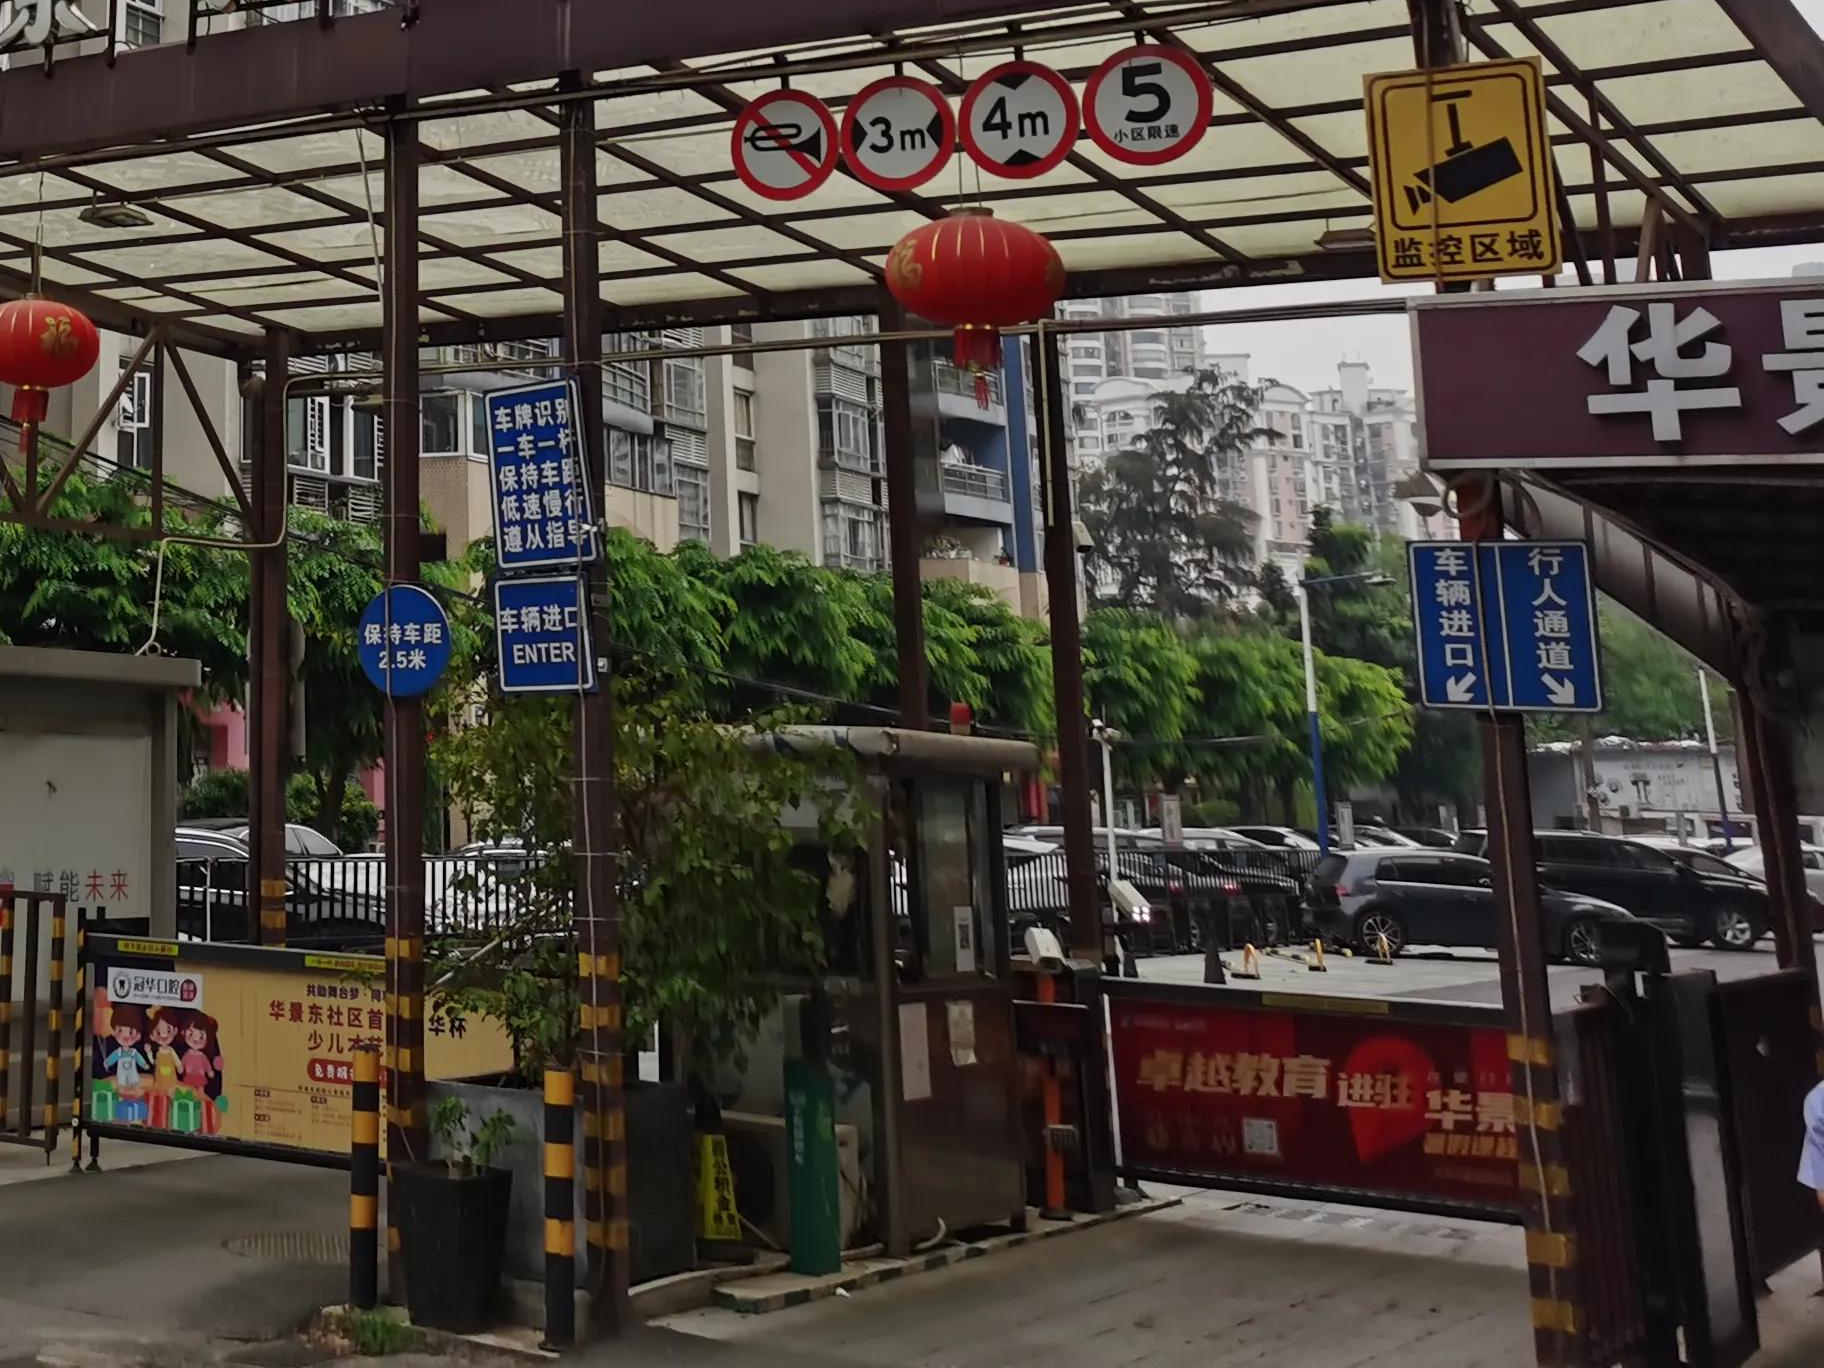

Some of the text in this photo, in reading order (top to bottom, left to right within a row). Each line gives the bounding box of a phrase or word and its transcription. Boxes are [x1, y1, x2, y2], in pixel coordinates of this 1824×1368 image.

[1121, 62, 1171, 124] 5
[868, 116, 927, 154] 3m
[982, 95, 1050, 141] 4m
[1113, 124, 1181, 144] 小区限速
[1391, 228, 1545, 269] 监控区域
[494, 397, 571, 433] 车牌识别
[499, 456, 583, 493] 保持车距
[501, 486, 584, 523] 低速慢行
[503, 519, 589, 553] 遵从指导
[499, 603, 578, 634] 车辆进口
[1433, 548, 1476, 668] 车辆进口
[1527, 547, 1575, 671] 行人通道
[363, 622, 443, 647] 保持车距
[377, 648, 428, 671] 2.5米
[512, 641, 577, 665] ENTER
[33, 868, 128, 902] 赋能未来
[269, 999, 384, 1032] 华景东社区首
